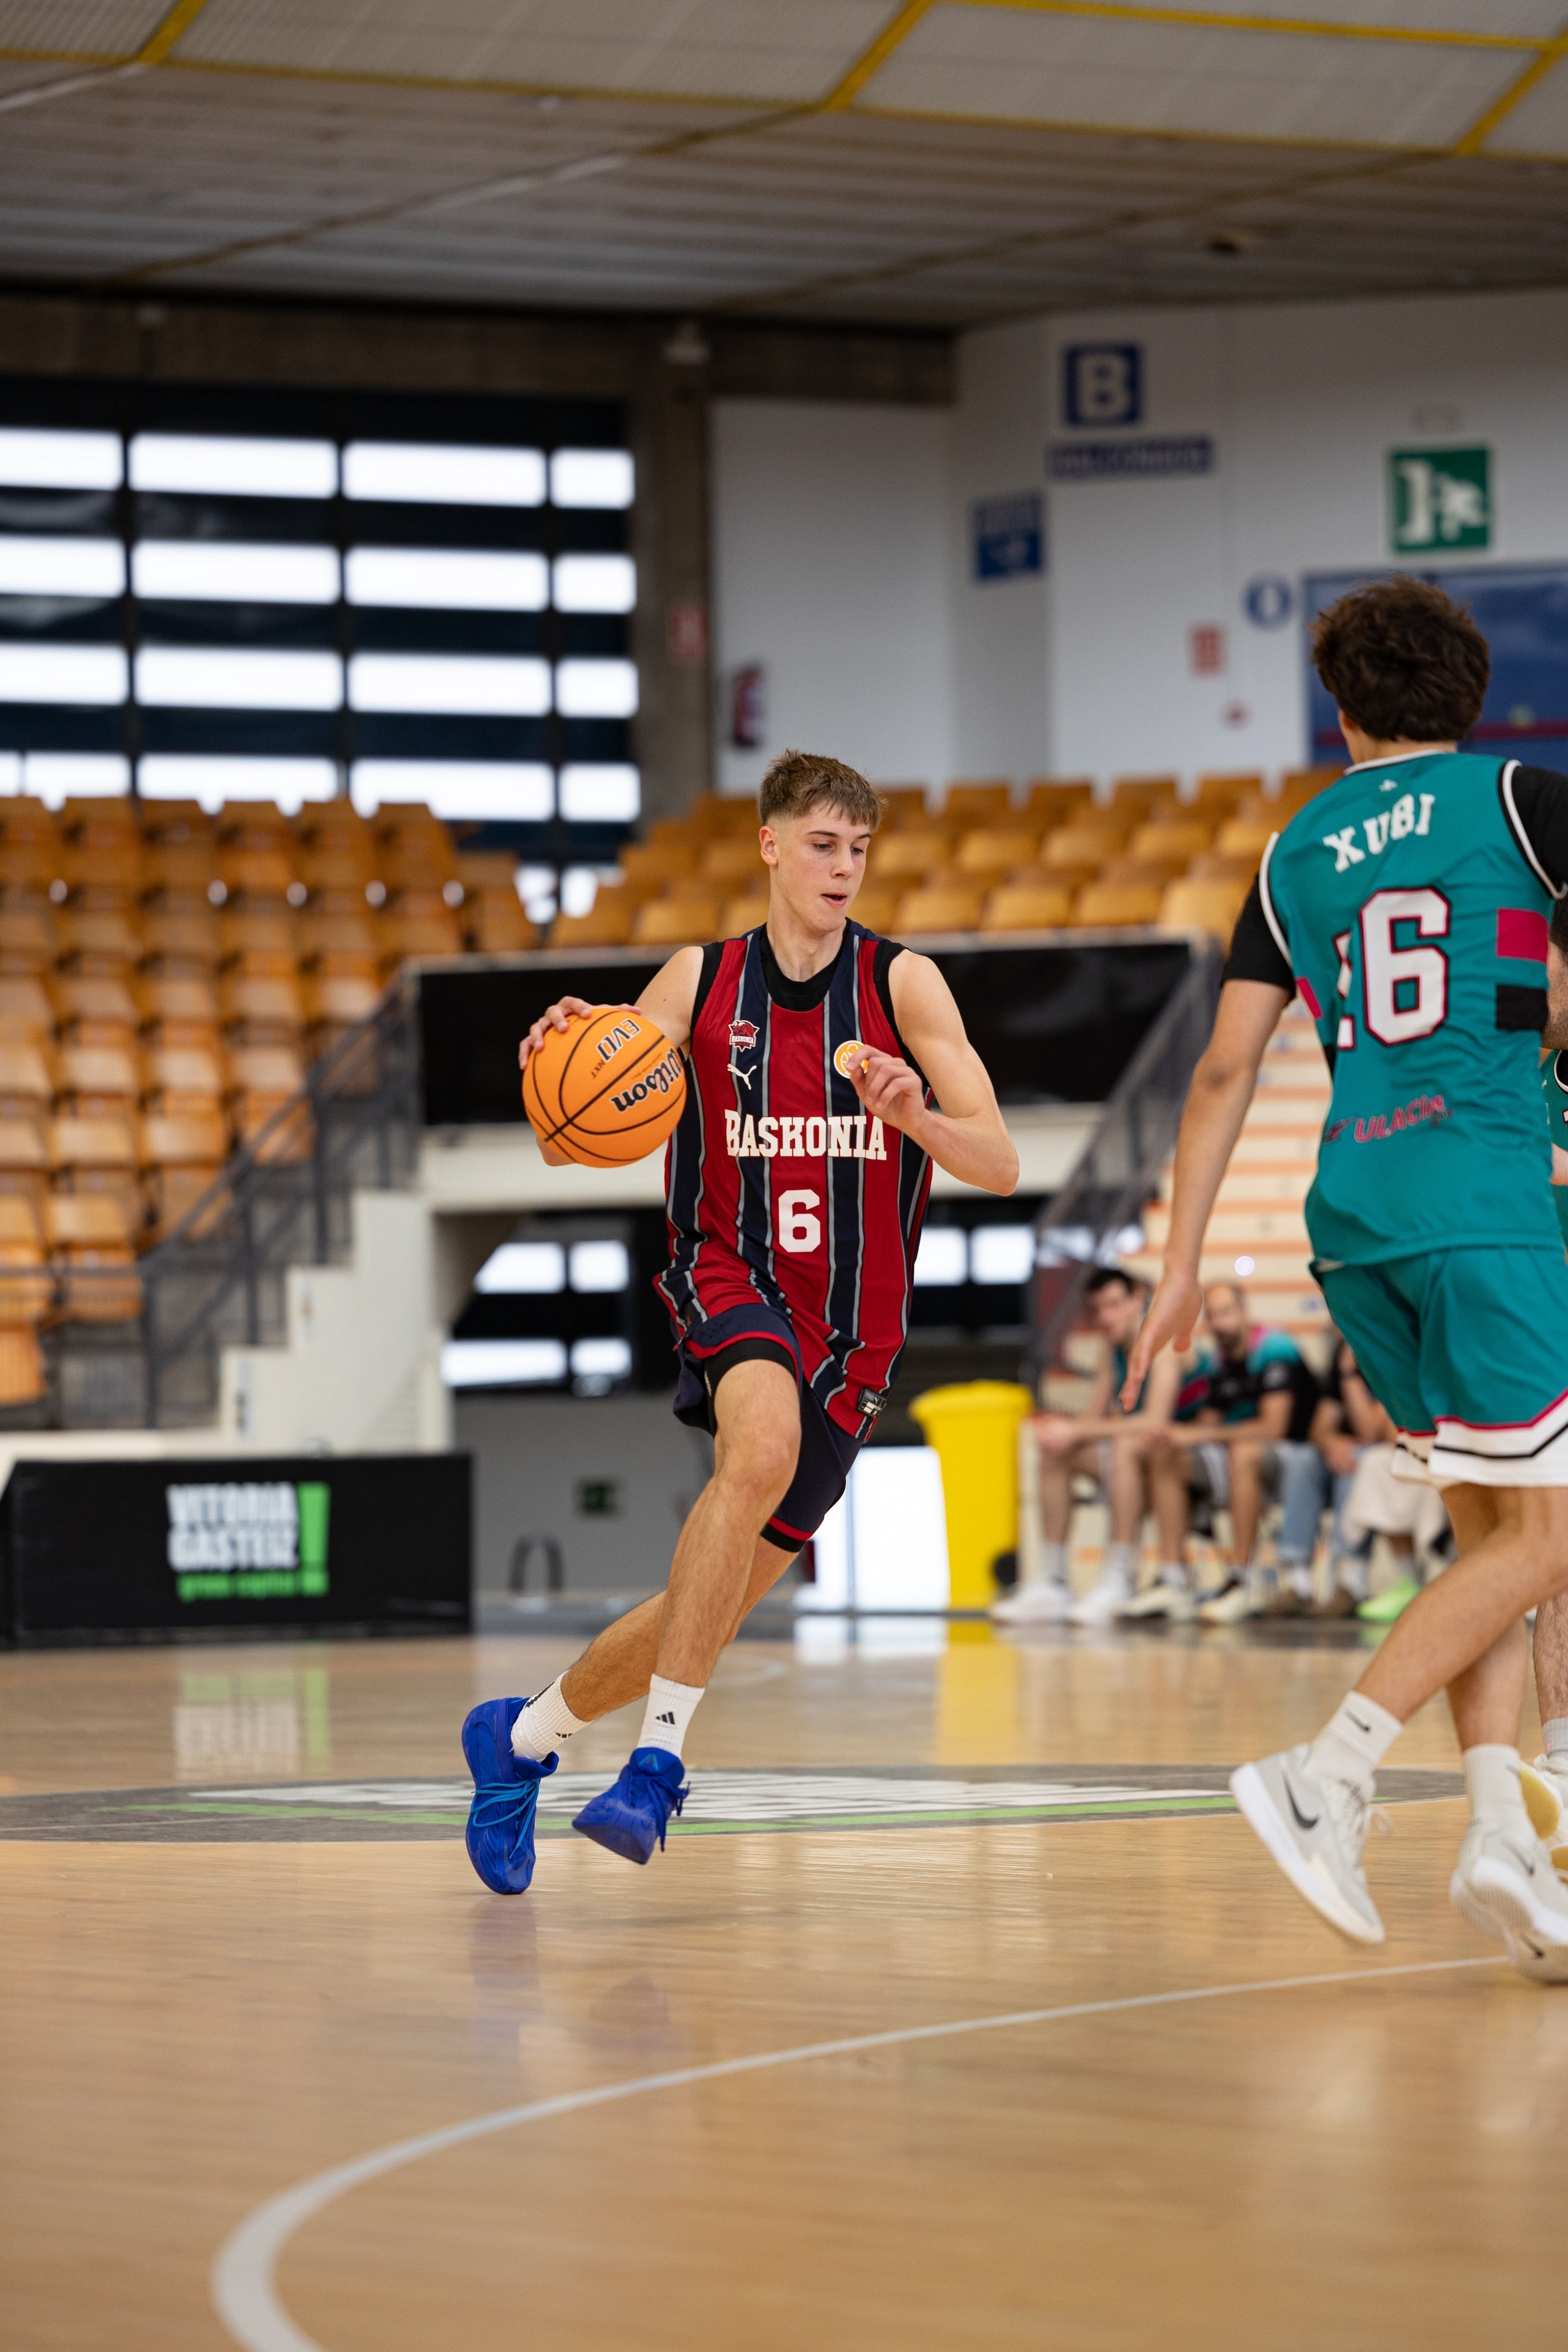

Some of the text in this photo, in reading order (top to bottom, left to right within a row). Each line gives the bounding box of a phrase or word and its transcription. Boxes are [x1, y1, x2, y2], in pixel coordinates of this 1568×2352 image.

[1077, 354, 1129, 416] B
[1322, 793, 1436, 873] XUBI
[610, 1047, 683, 1112] Wilson
[724, 1109, 887, 1160] BASKONIA
[778, 1189, 821, 1253] 6
